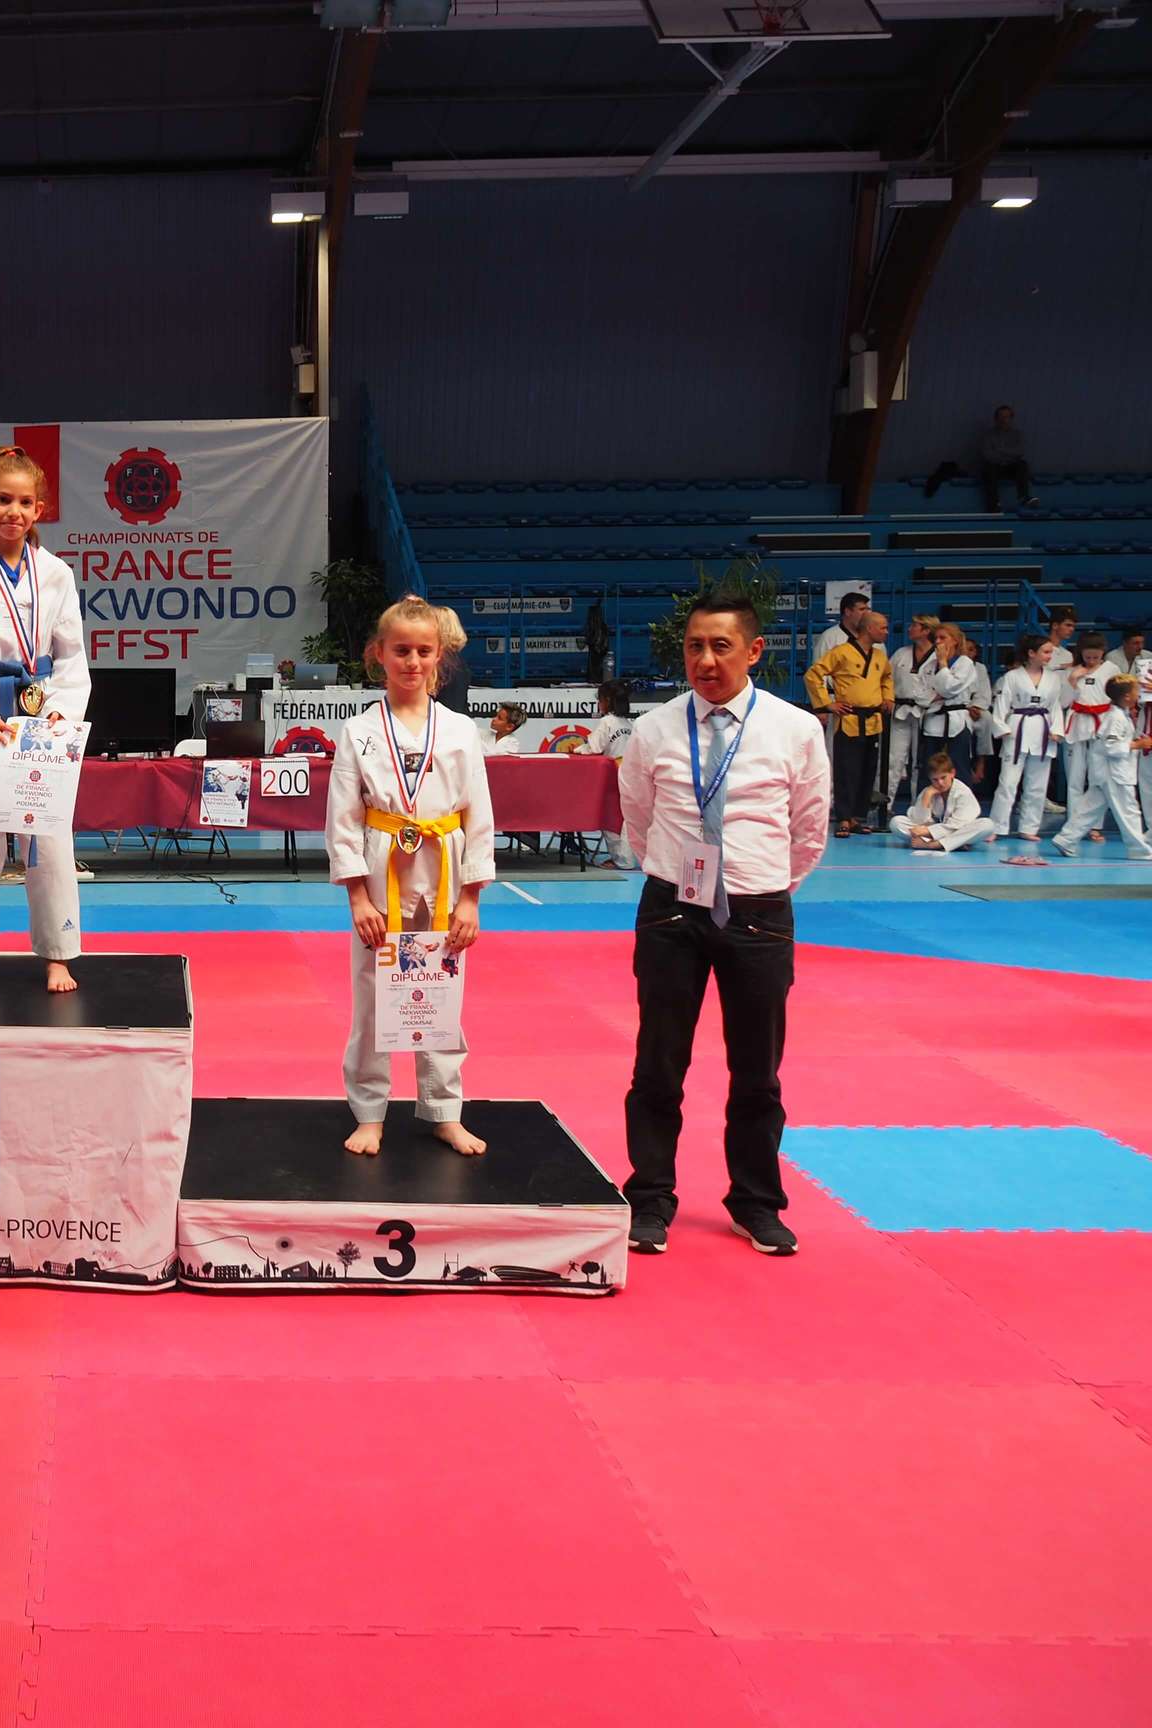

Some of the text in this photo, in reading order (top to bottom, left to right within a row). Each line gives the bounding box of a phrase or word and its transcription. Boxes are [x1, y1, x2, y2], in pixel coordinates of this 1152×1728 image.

[67, 531, 219, 545] CHAMPIONNATS DE
[79, 585, 297, 621] KWONDO
[90, 628, 199, 661] FFST
[273, 699, 357, 720] FÉDÉRATION
[12, 751, 65, 765] DIPLÔME
[262, 769, 309, 795] 200
[378, 942, 397, 967] 3
[391, 970, 445, 983] DIPLÔME
[373, 1219, 417, 1279] 3
